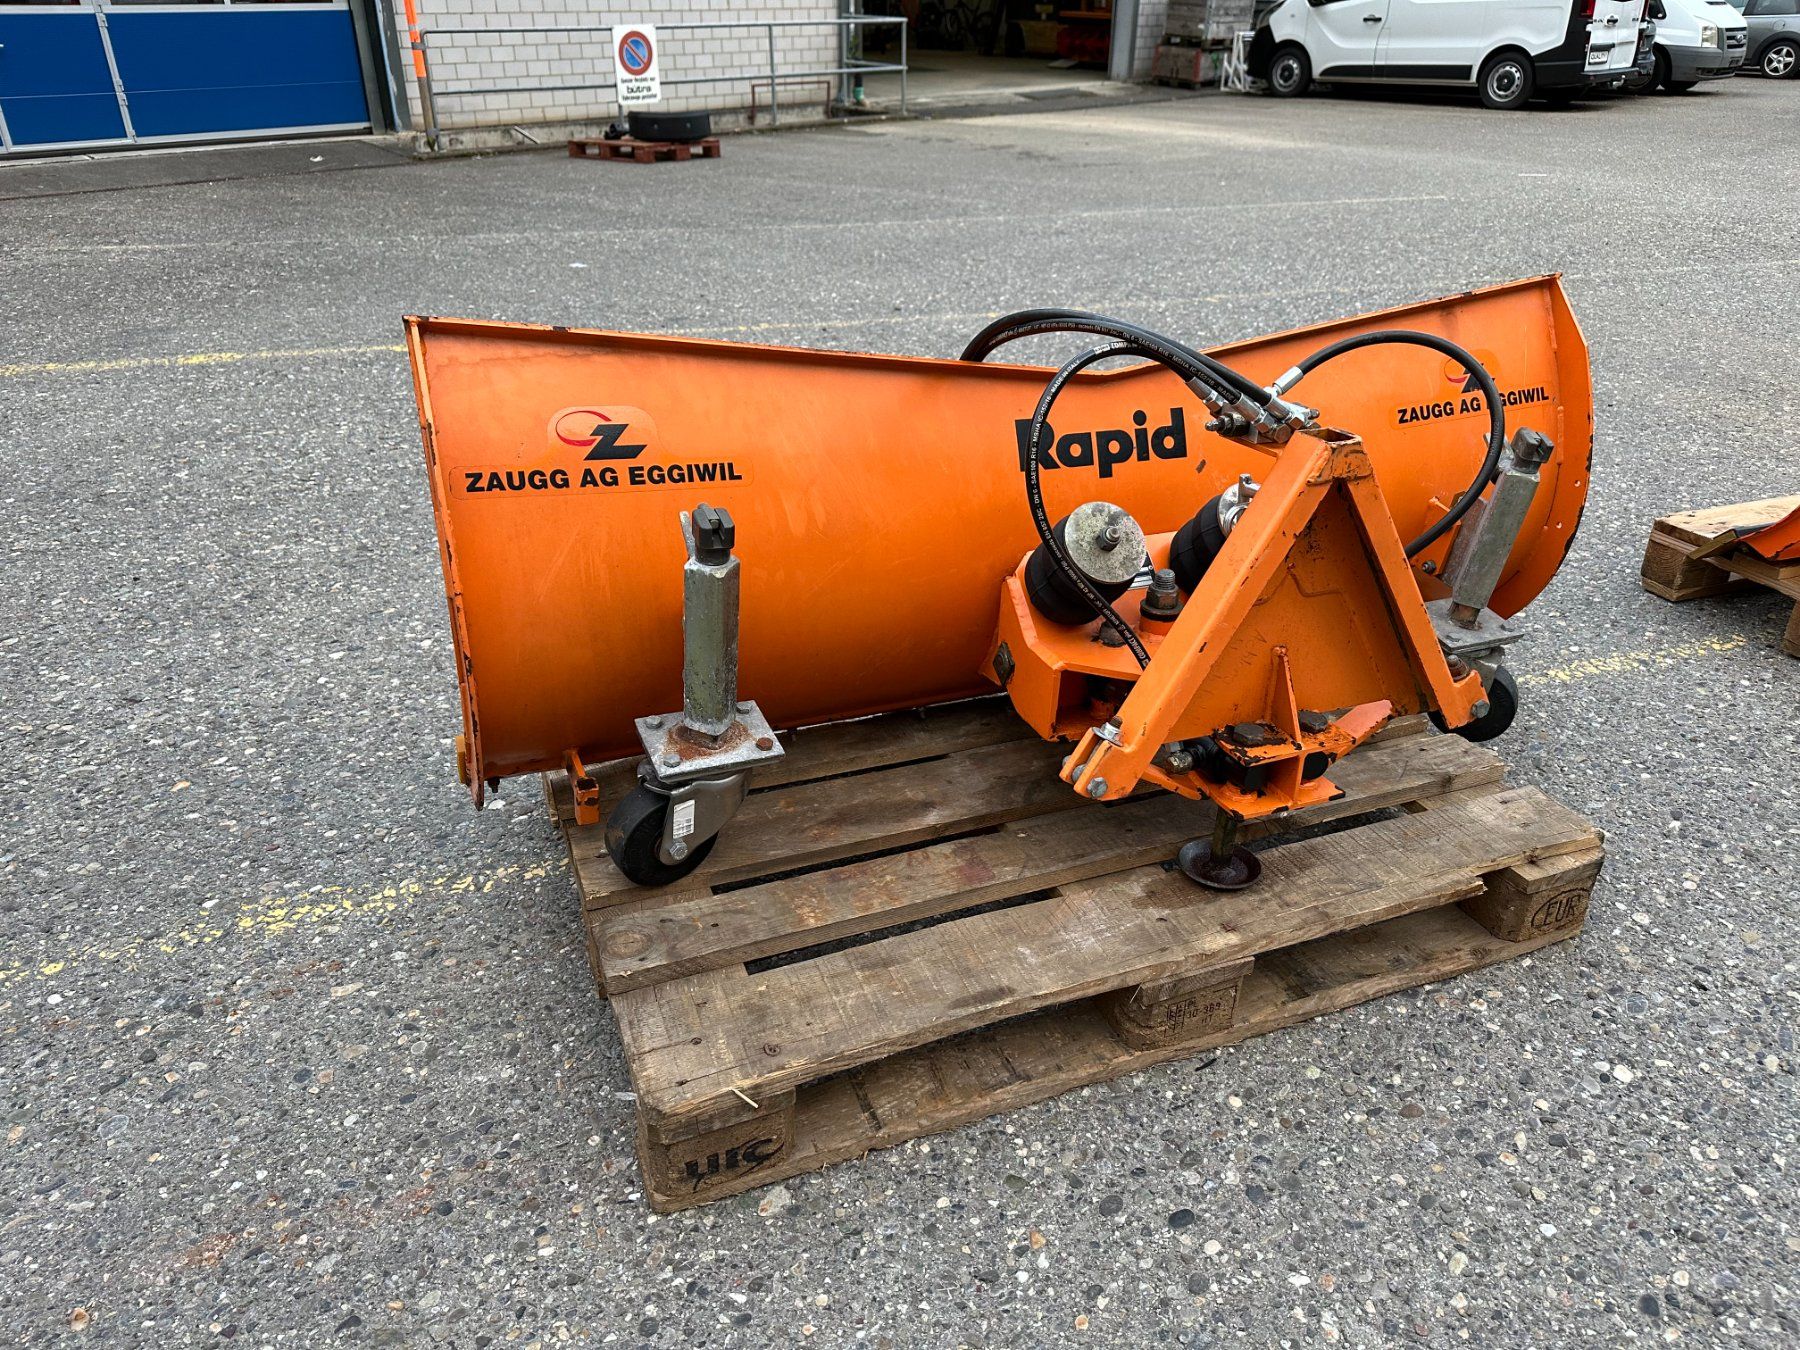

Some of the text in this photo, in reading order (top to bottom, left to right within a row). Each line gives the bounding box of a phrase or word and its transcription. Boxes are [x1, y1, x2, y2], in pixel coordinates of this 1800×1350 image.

[1398, 400, 1454, 424] ZAUGG
[1459, 396, 1481, 415] AG
[1014, 407, 1188, 479] Rapid
[465, 462, 743, 493] ZAUGG AG EGGIWIL
[1543, 894, 1581, 926] EUR
